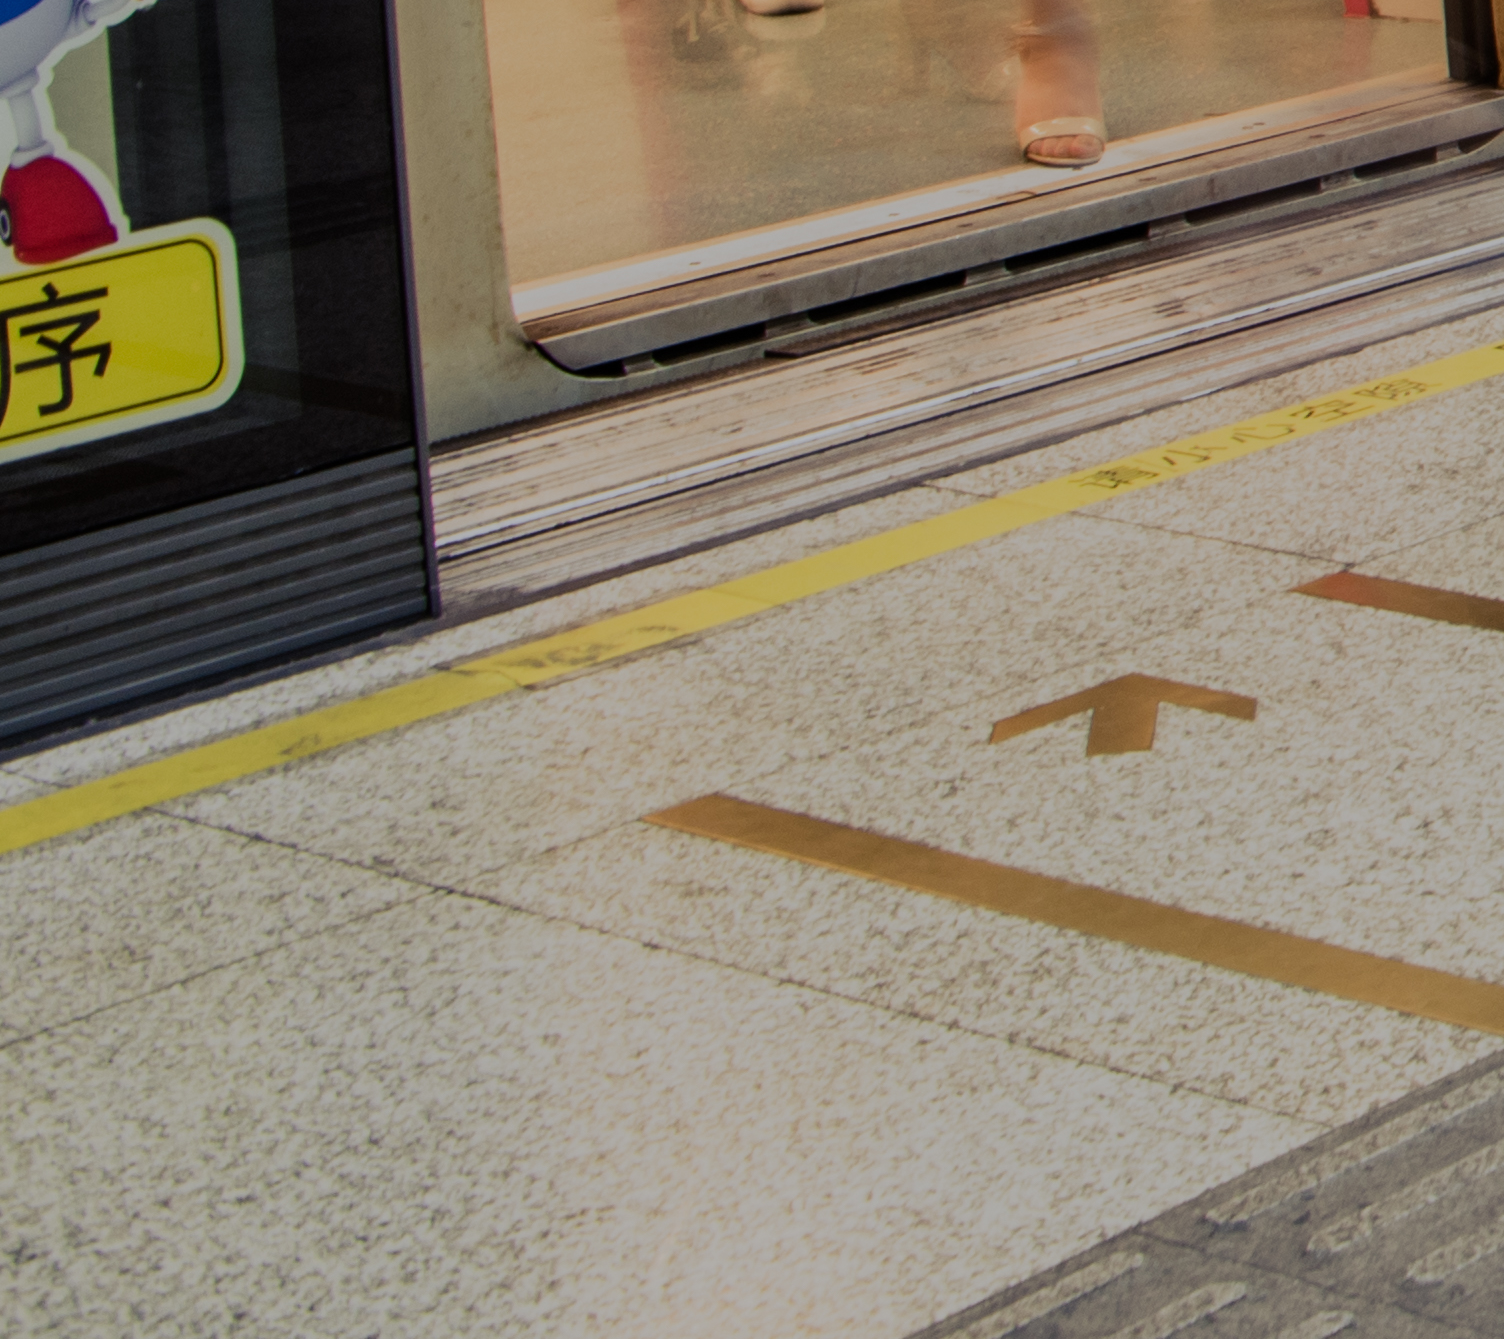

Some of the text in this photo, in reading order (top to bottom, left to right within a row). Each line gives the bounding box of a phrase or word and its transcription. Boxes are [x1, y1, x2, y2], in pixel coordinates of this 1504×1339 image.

[1068, 378, 1443, 490] 请小心空隙
